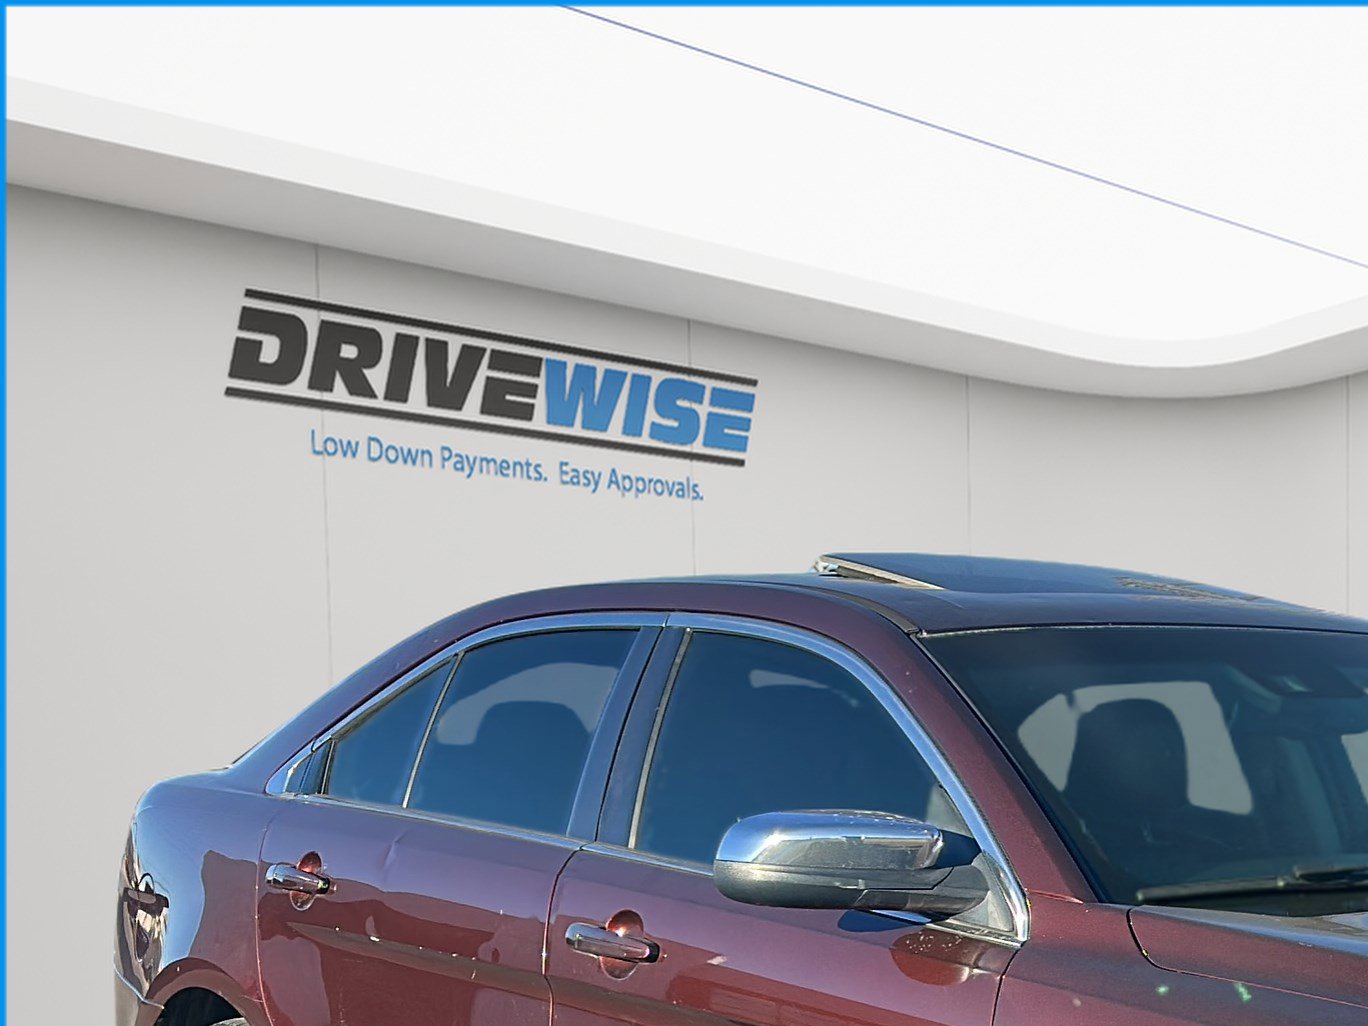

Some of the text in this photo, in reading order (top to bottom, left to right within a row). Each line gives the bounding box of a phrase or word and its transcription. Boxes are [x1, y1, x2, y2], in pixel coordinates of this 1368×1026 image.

[227, 305, 757, 453] DRIVEWISE
[309, 428, 705, 502] Low Down Payments. Easy Approvals.
